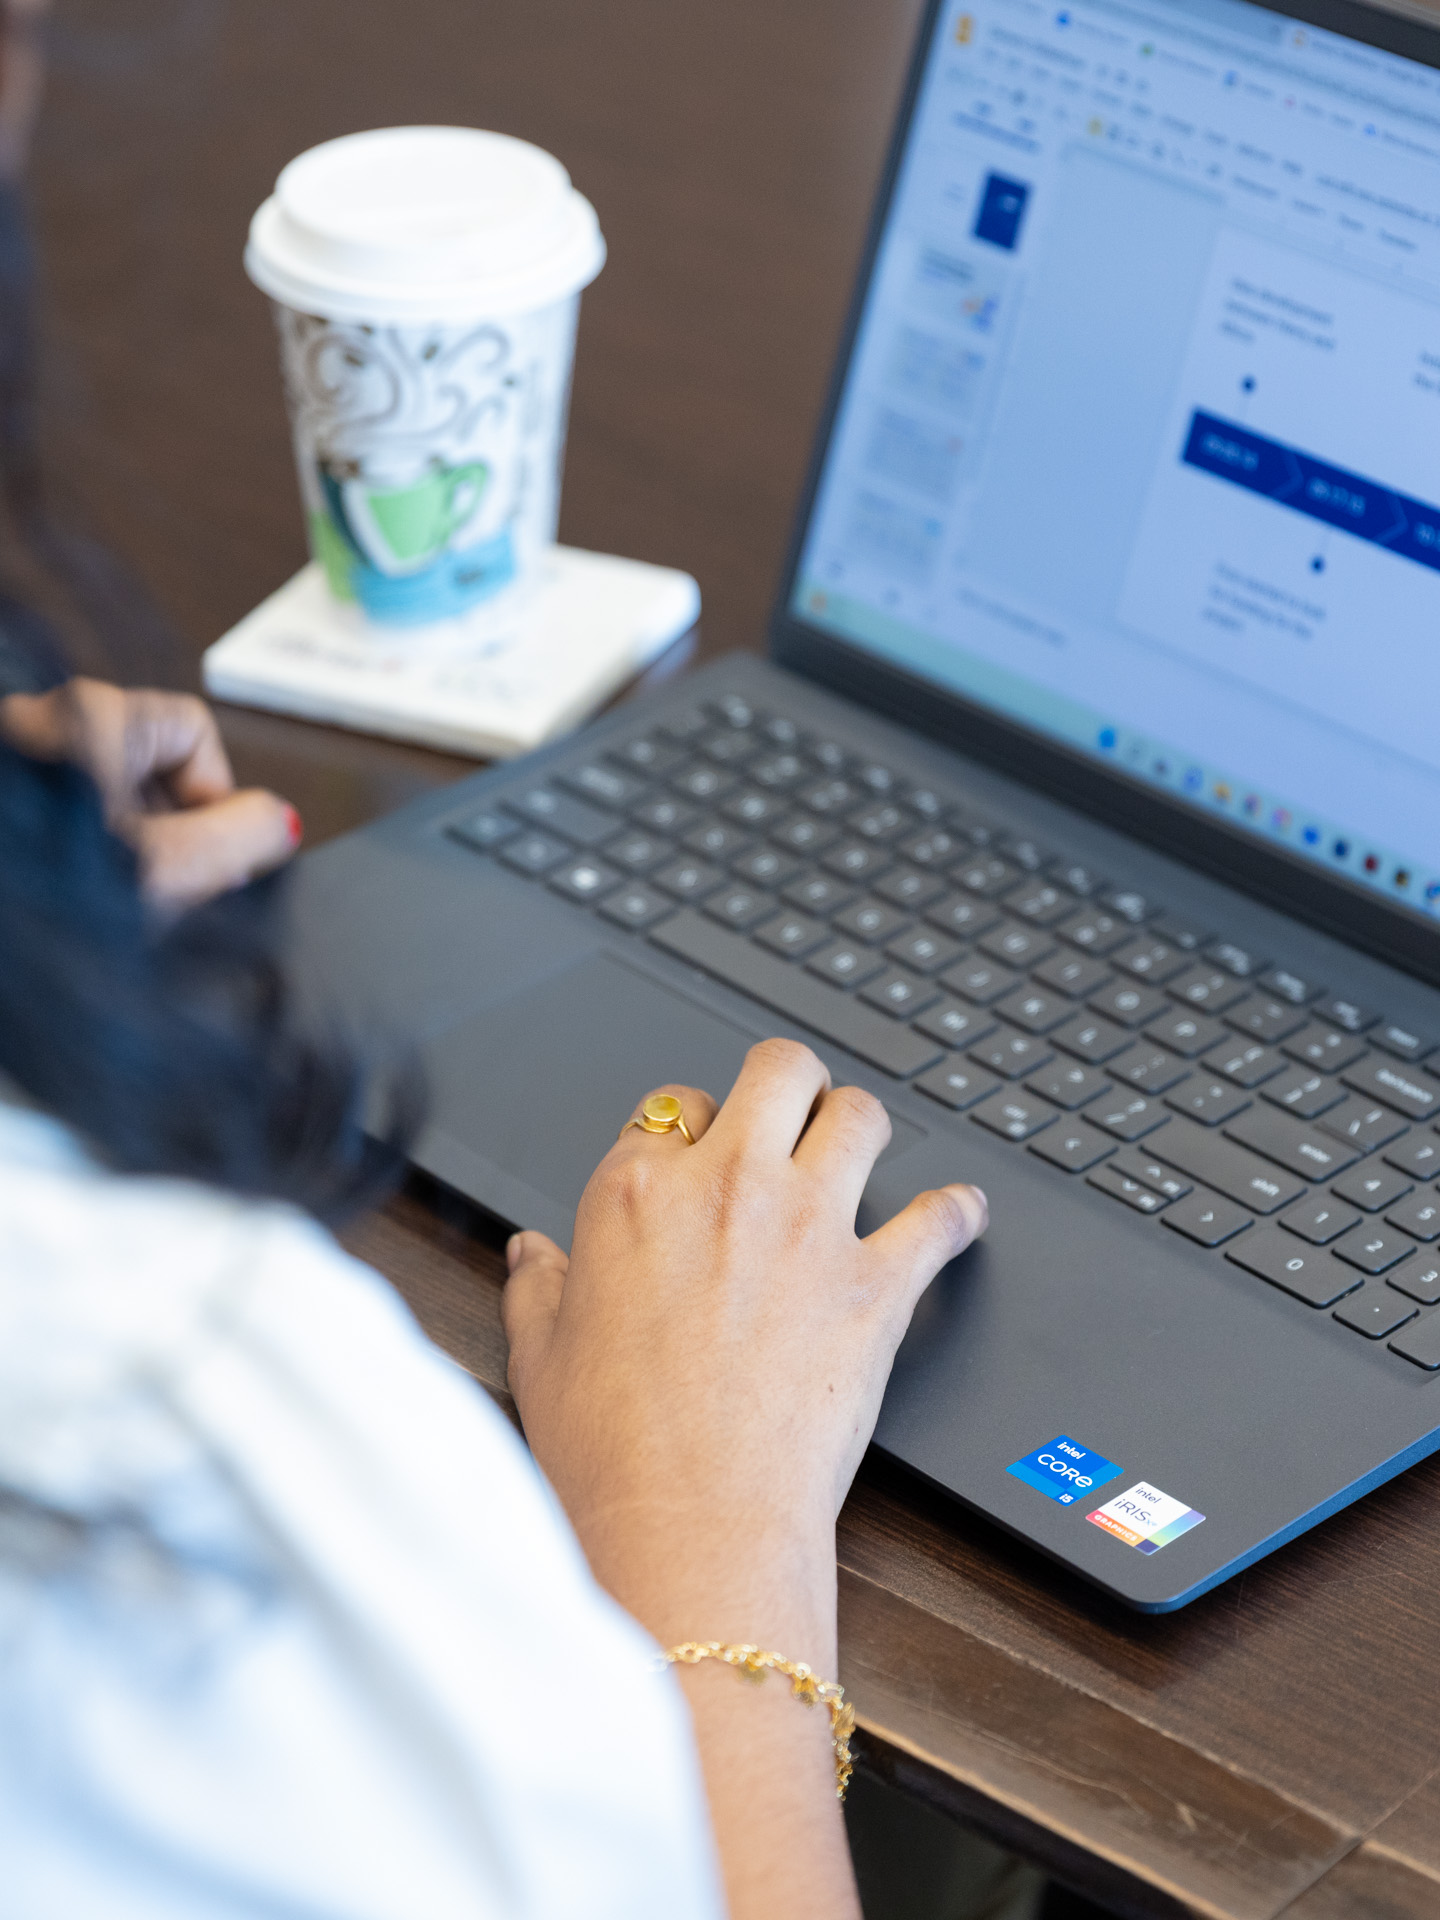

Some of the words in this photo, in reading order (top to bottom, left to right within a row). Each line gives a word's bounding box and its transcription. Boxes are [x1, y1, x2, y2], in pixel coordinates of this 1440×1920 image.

[1364, 1240, 1384, 1252] 2
[1285, 1258, 1304, 1271] 0
[1421, 1271, 1439, 1283] 3
[1057, 1441, 1087, 1460] intel
[1058, 1493, 1075, 1504] i5
[1135, 1487, 1162, 1504] intel
[1093, 1514, 1138, 1542] GRAPHICS
